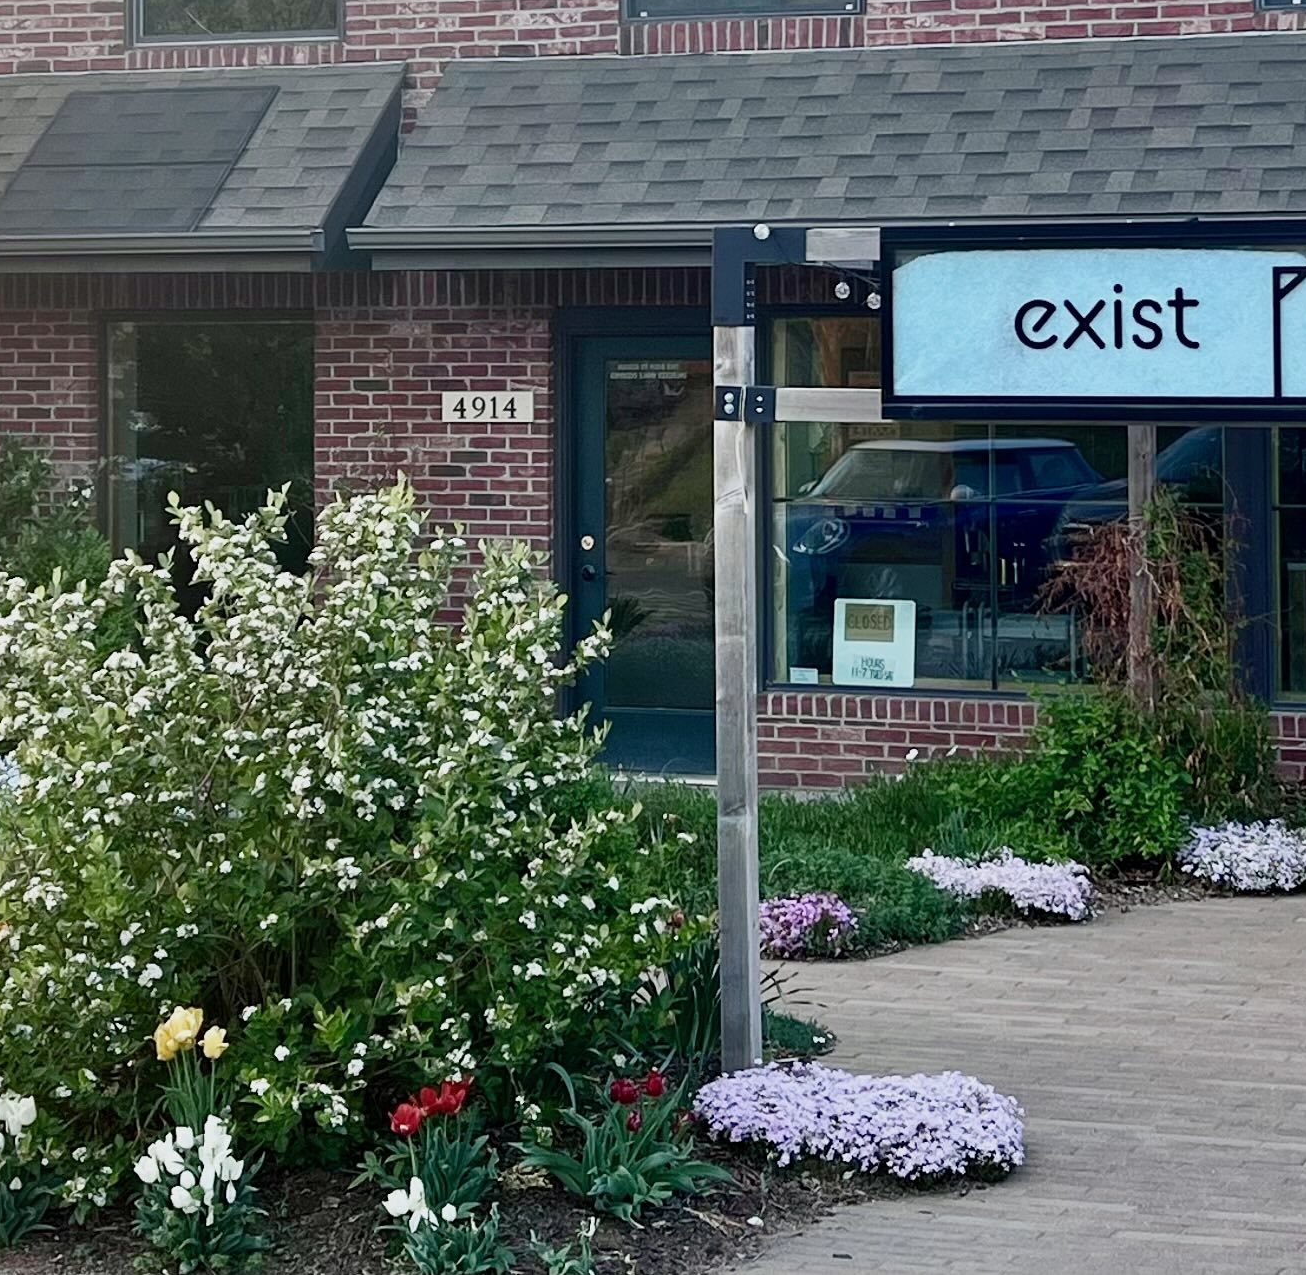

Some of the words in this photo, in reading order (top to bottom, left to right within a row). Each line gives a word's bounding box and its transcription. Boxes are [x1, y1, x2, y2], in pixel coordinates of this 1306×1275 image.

[1014, 283, 1200, 350] exist
[452, 396, 517, 419] 4914
[847, 613, 892, 631] CLOSED
[861, 657, 885, 670] HOURS
